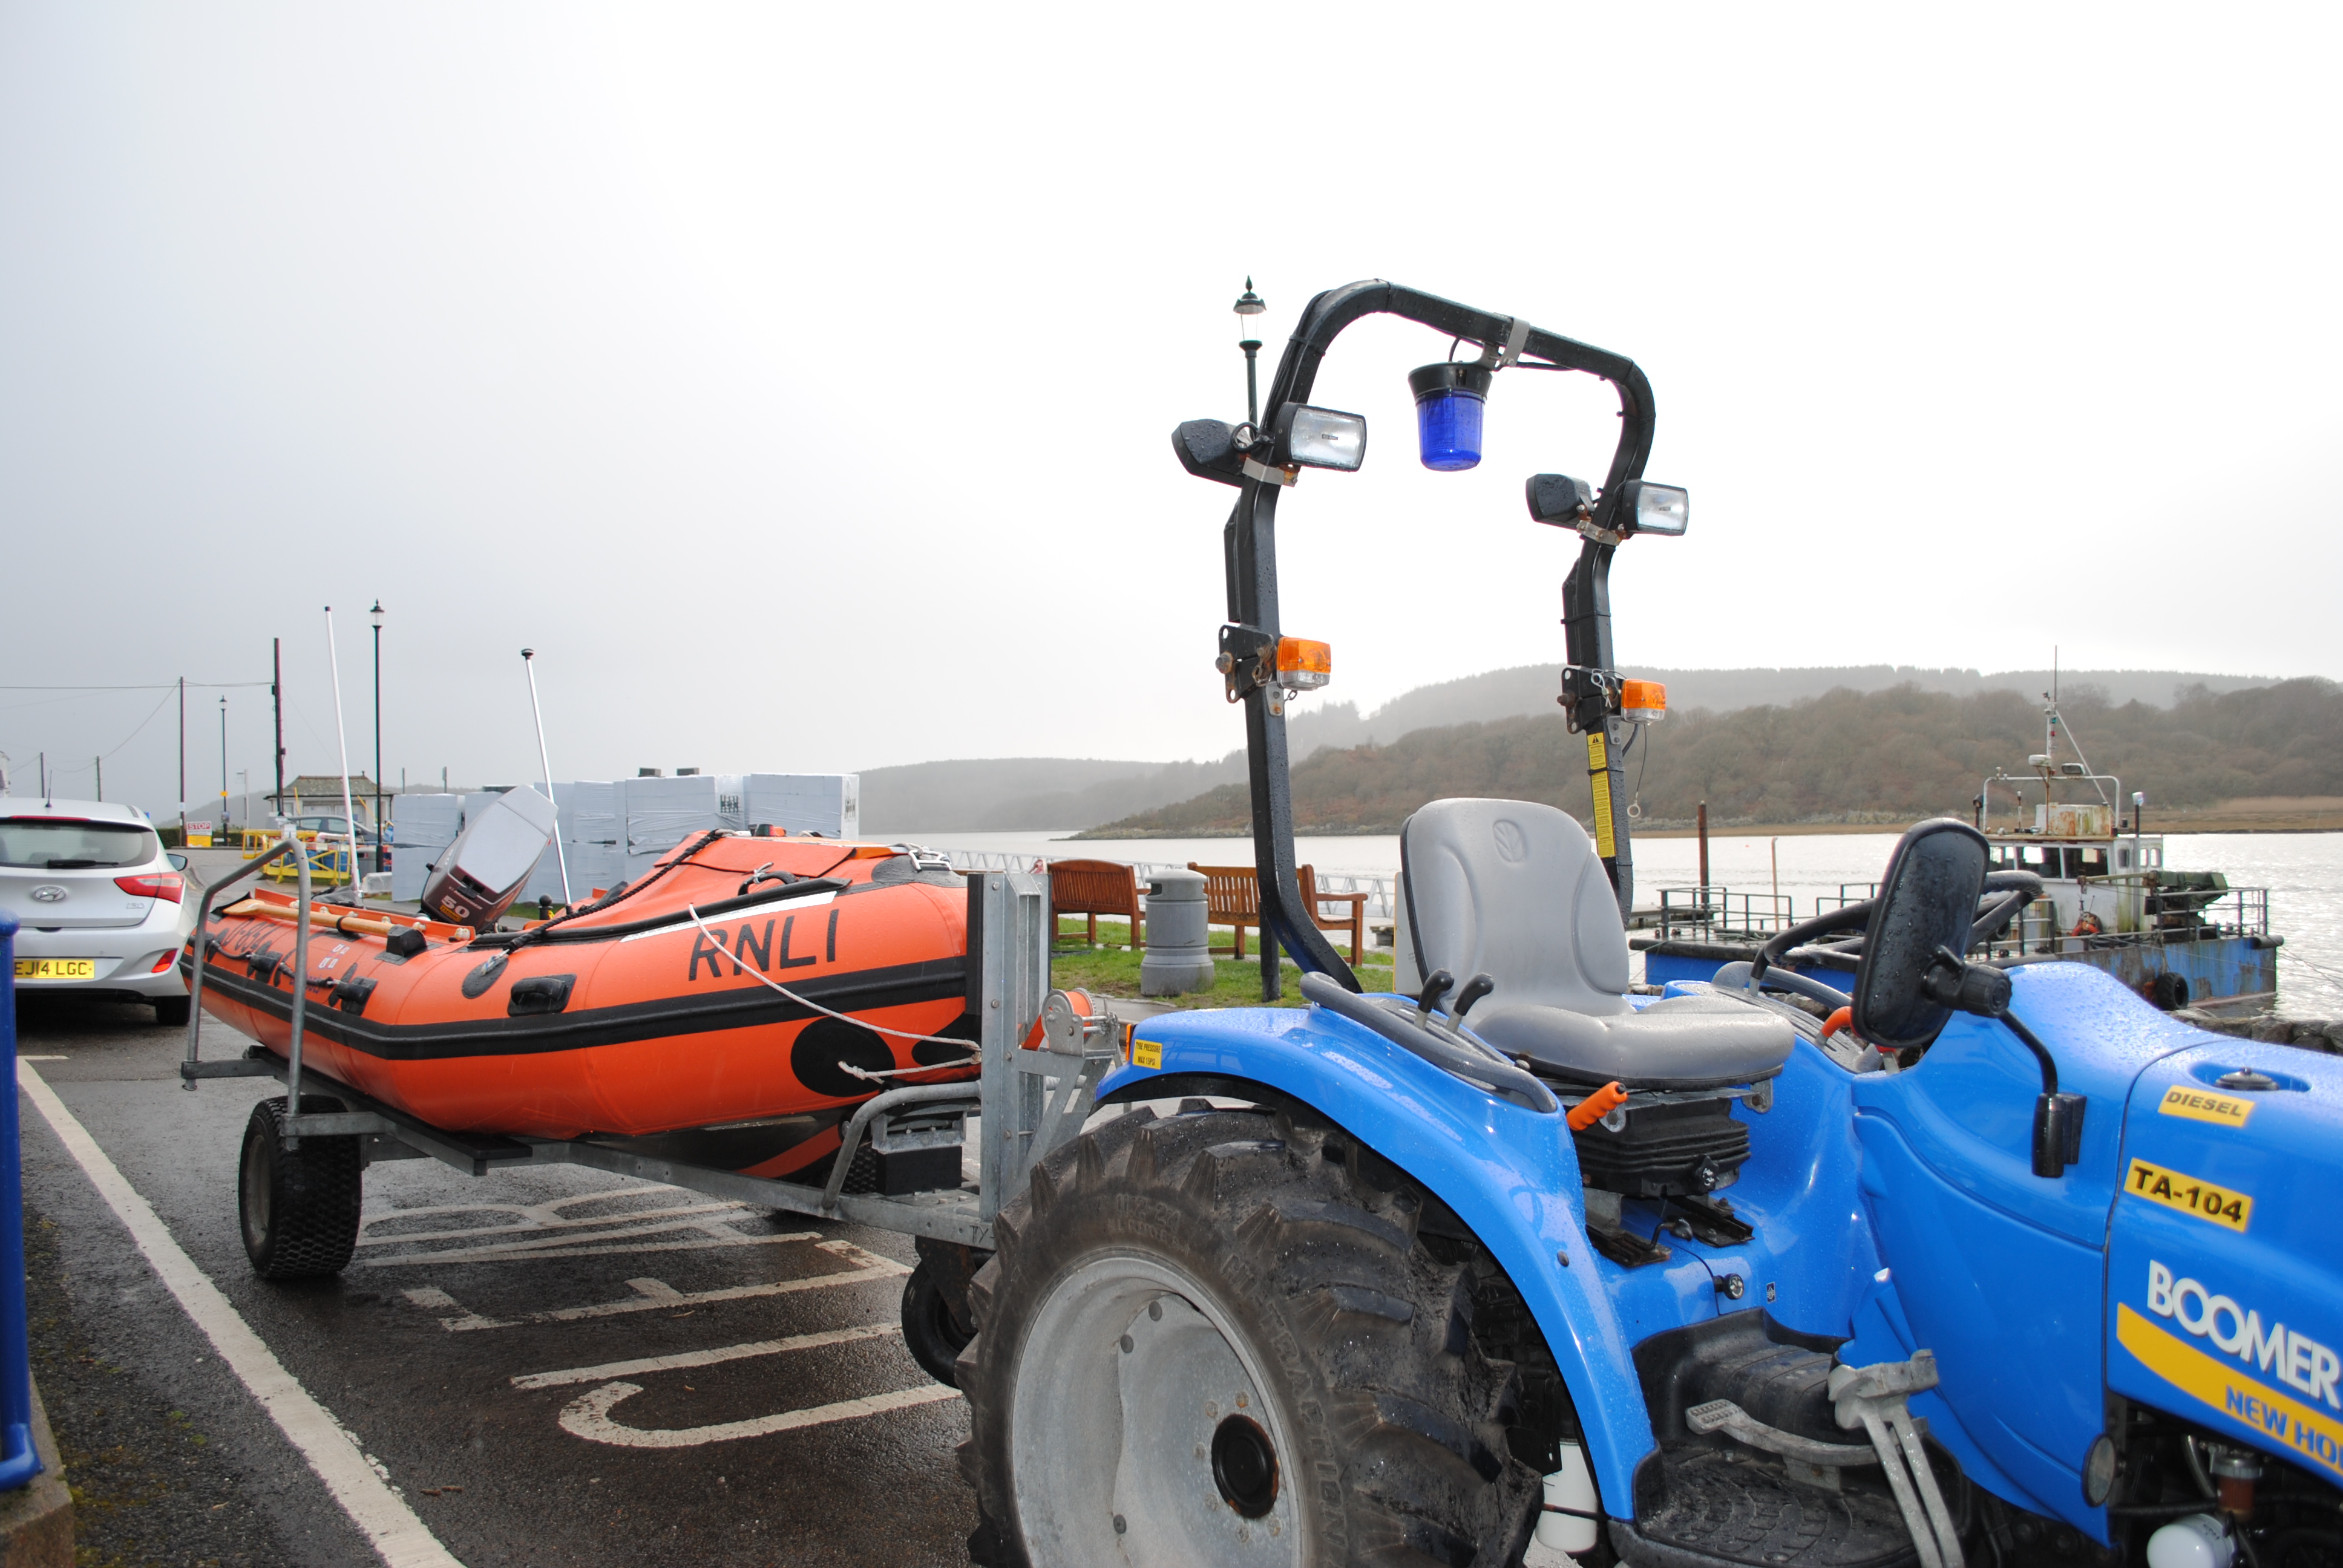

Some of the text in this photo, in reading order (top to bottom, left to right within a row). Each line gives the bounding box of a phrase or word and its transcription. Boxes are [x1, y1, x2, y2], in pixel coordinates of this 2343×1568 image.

[441, 895, 470, 918] 50
[689, 909, 839, 981] RNLI
[15, 962, 88, 975] EJ14 LGC
[1144, 1043, 1161, 1053] PRESSURE
[2165, 1091, 2241, 1117] DIESEL
[2133, 1165, 2243, 1223] TA-104
[2147, 1259, 2342, 1412] BOOMER
[2226, 1384, 2289, 1439] NEW
